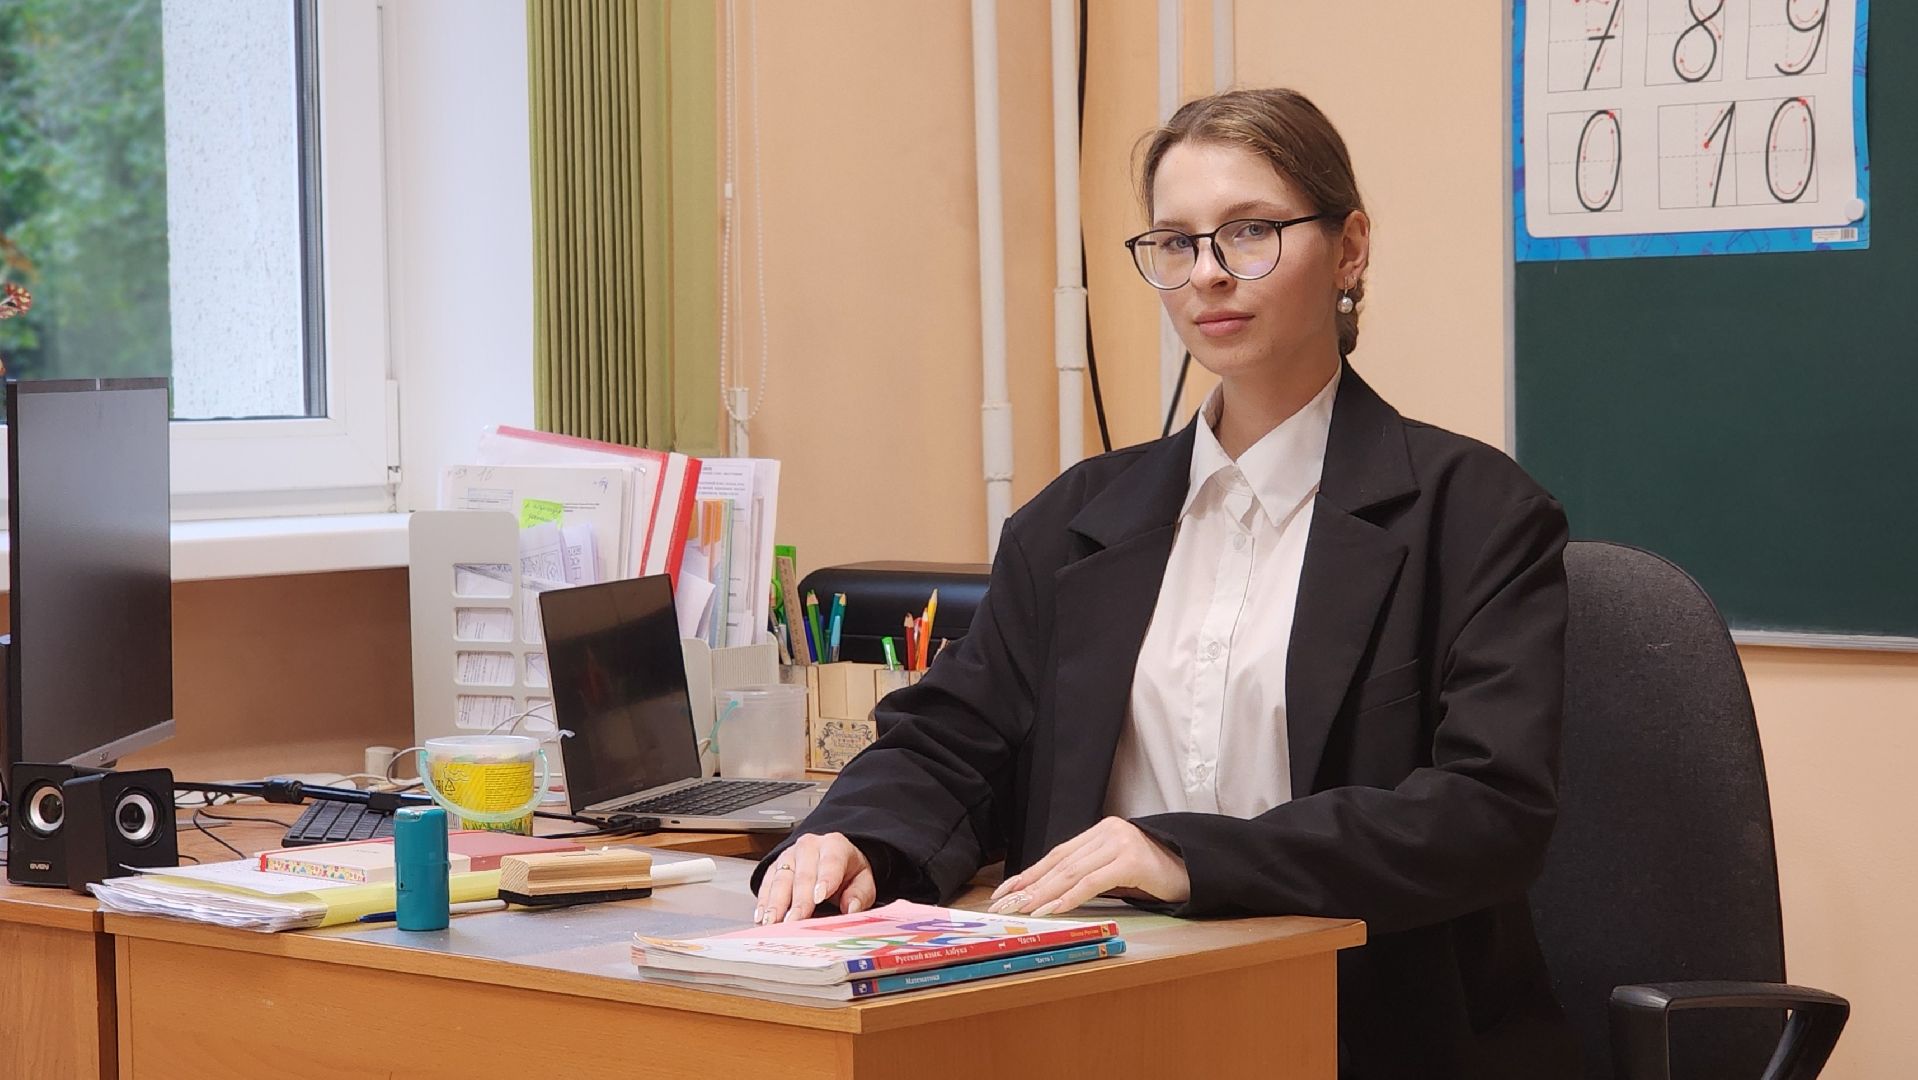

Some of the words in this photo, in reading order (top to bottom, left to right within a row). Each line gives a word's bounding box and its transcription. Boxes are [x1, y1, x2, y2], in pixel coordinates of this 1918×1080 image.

[1583, 0, 1621, 90] 7
[1673, 0, 1723, 82] 8
[1776, 0, 1829, 76] 9
[1575, 109, 1622, 212] 0
[1704, 97, 1816, 208] 10
[1017, 935, 1037, 944] Часть
[895, 953, 923, 964] Русский
[905, 974, 940, 984] Математика
